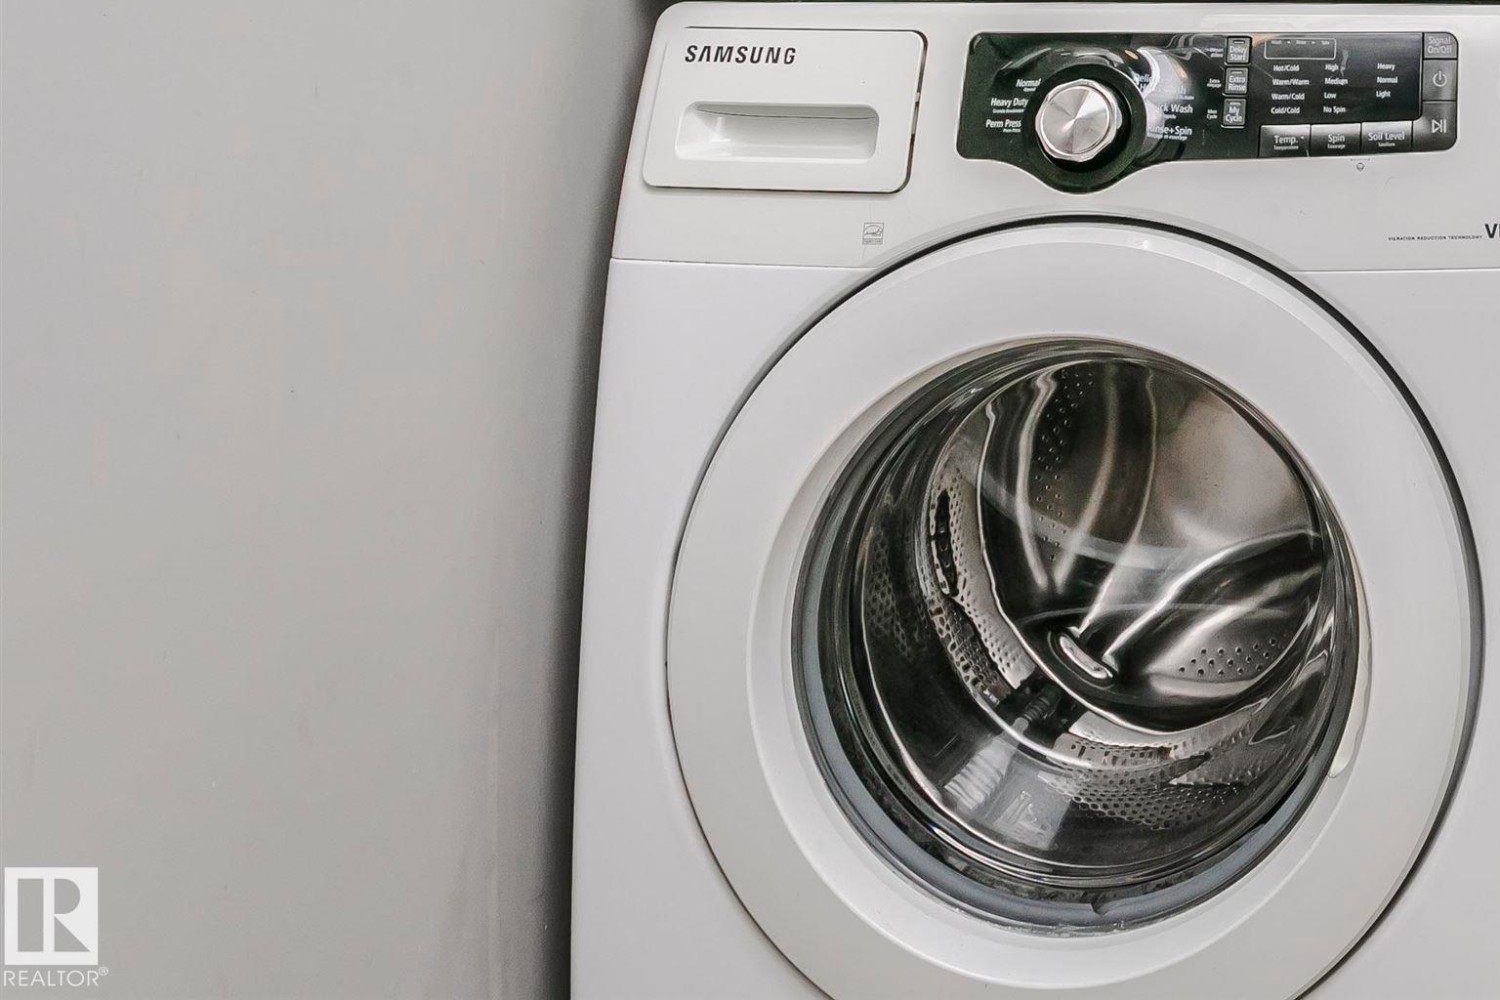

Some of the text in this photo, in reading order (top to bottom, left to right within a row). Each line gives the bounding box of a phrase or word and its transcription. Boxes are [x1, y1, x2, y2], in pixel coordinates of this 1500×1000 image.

[1428, 36, 1451, 46] Signal
[1229, 46, 1247, 55] Delay
[1427, 45, 1452, 54] On/Off
[684, 44, 796, 65] SAMSUNG
[1230, 53, 1246, 61] Start
[1273, 64, 1300, 72] Hot/Cold
[1325, 64, 1339, 72] High
[1377, 63, 1396, 71] Heavy
[1015, 78, 1041, 88] Normal
[1229, 75, 1246, 83] Extra
[1324, 78, 1349, 86] Medium
[1376, 76, 1398, 84] Normal
[1228, 83, 1246, 91] Rinse
[1271, 92, 1305, 100] Warm/Cold
[1376, 90, 1391, 99] Light
[990, 97, 1029, 108] Heavy Duty
[1171, 104, 1193, 114] Wash
[1229, 106, 1240, 117] My
[1271, 107, 1300, 115] Cold/Cold
[1333, 106, 1346, 114] Spin
[985, 119, 1022, 128] Perm Press
[1225, 114, 1243, 124] Cycle
[1274, 135, 1299, 145] Temp.
[1328, 134, 1346, 144] Spin
[1368, 131, 1405, 141] Soil Level
